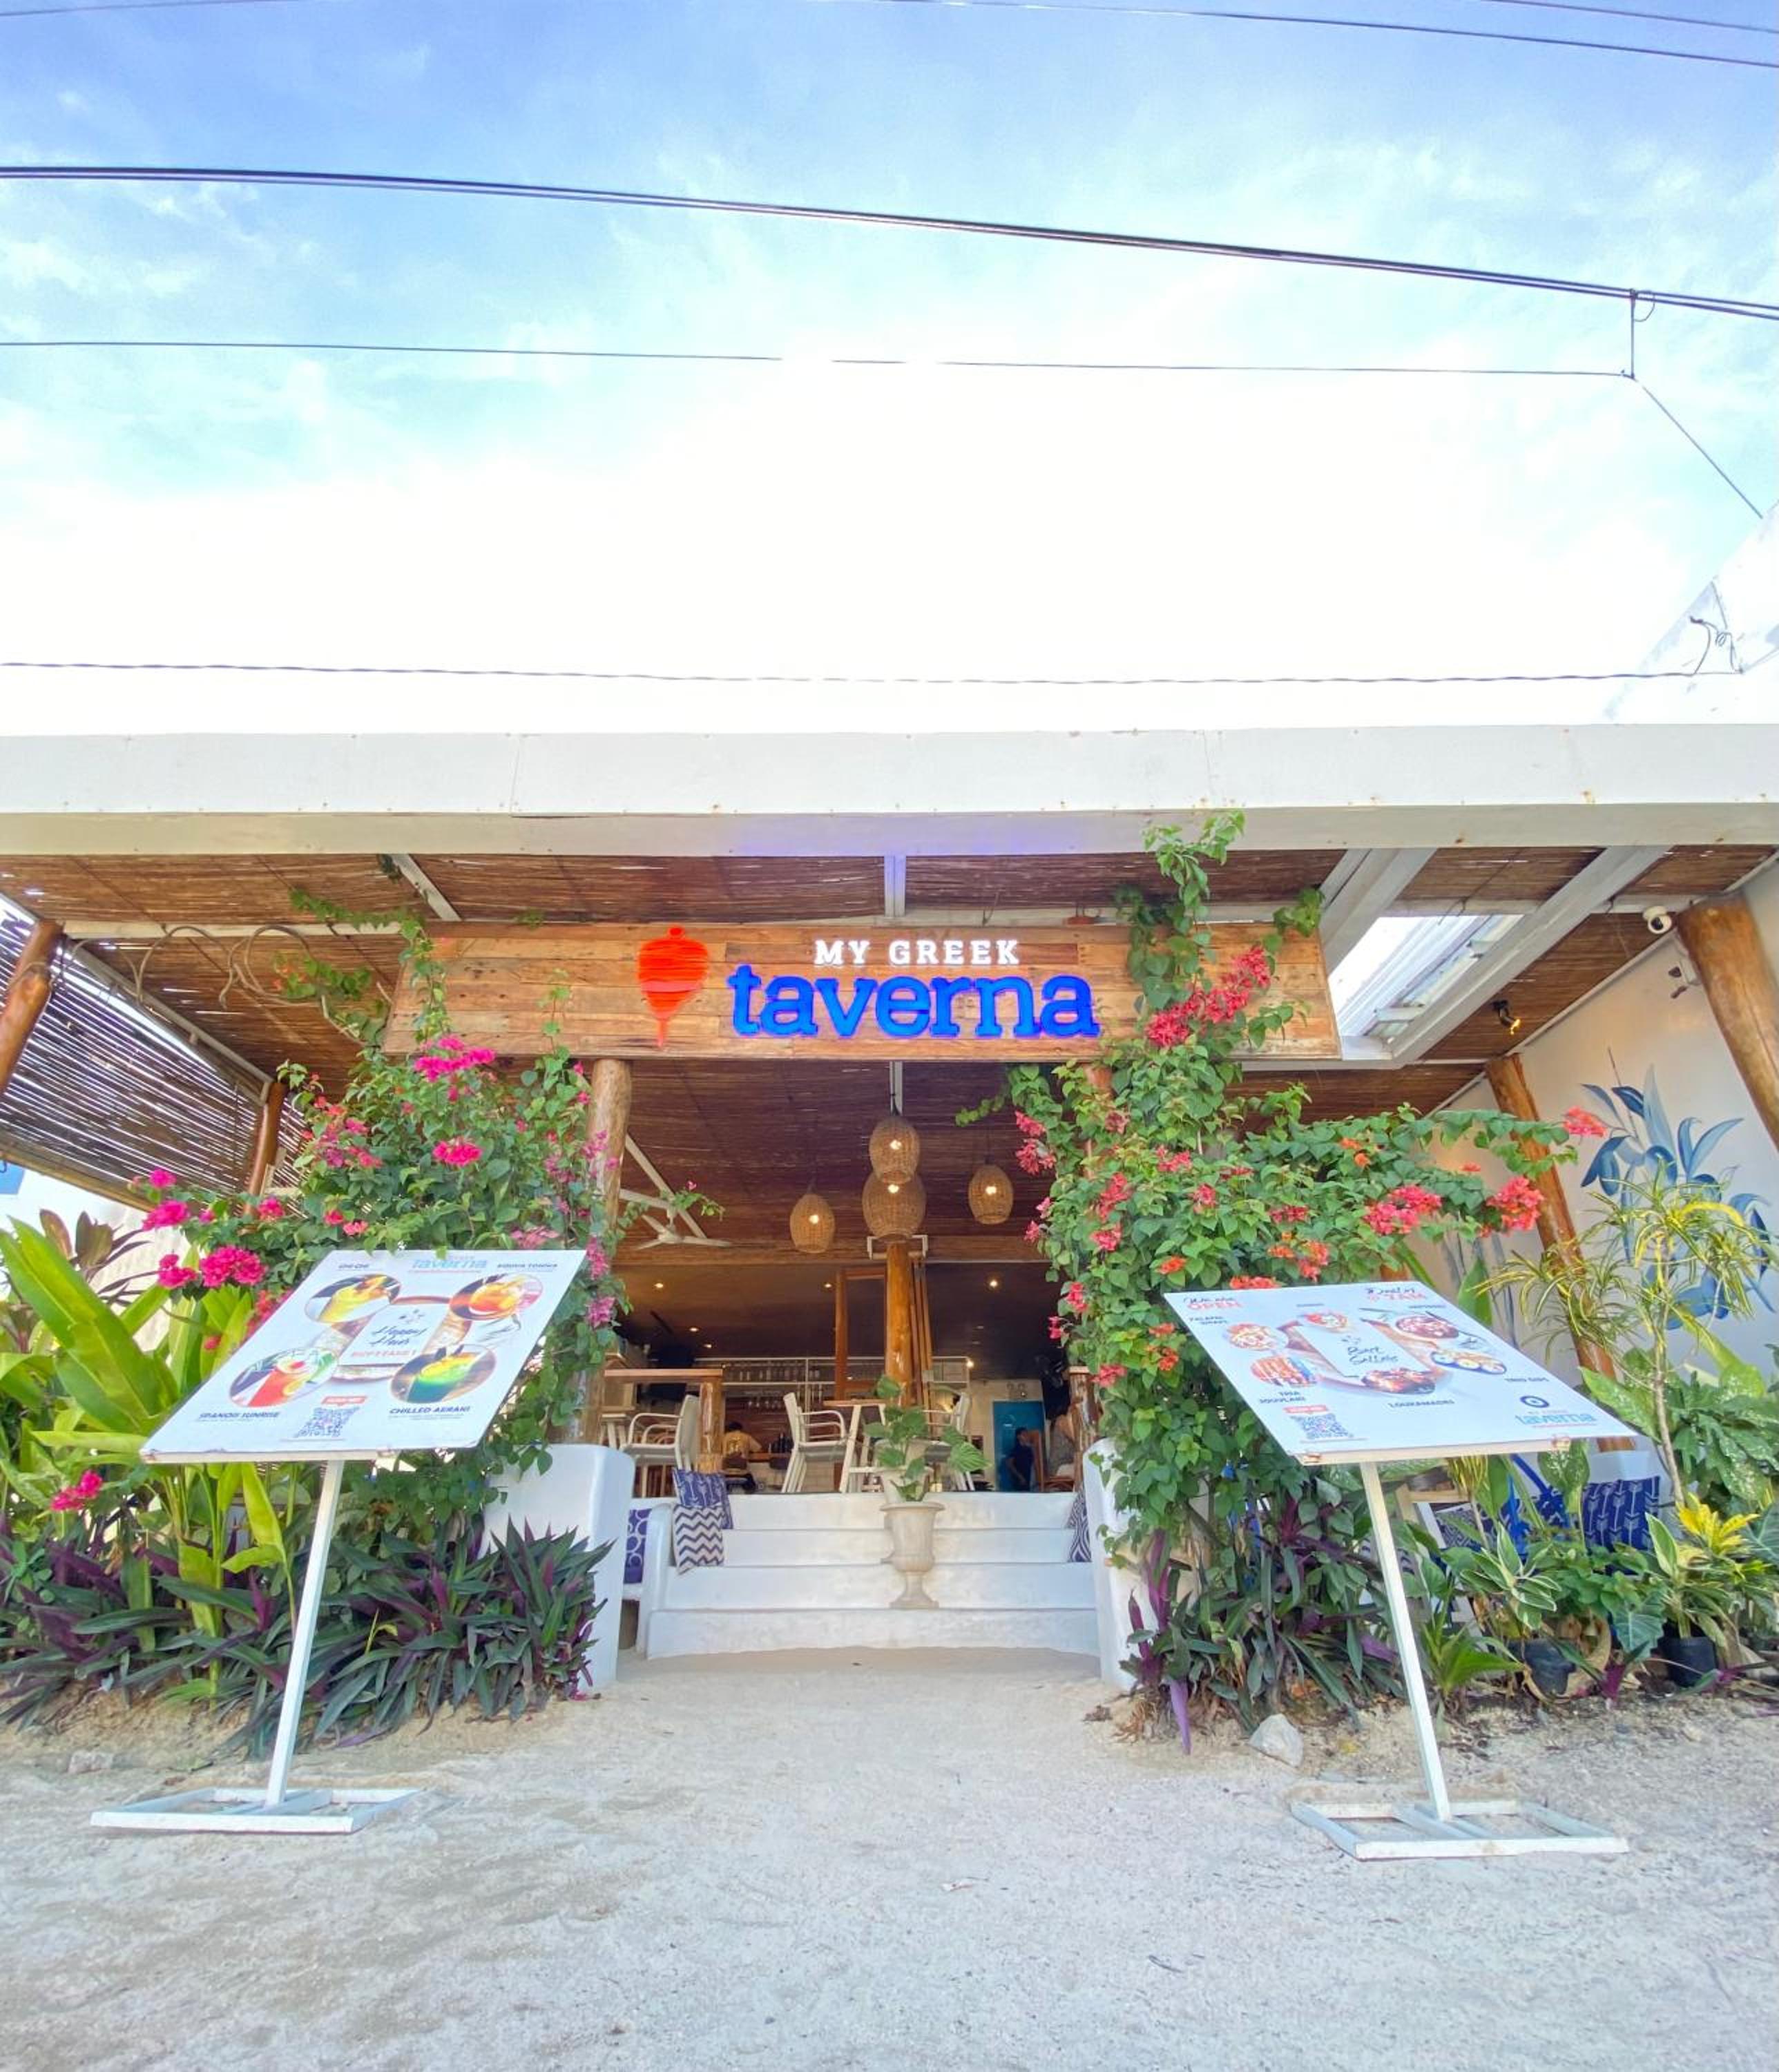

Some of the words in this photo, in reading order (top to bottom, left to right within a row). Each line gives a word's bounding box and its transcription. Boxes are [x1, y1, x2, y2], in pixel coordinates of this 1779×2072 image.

[814, 939, 870, 966] MY
[888, 939, 1021, 966] GREEK
[726, 963, 1101, 1038] taverna
